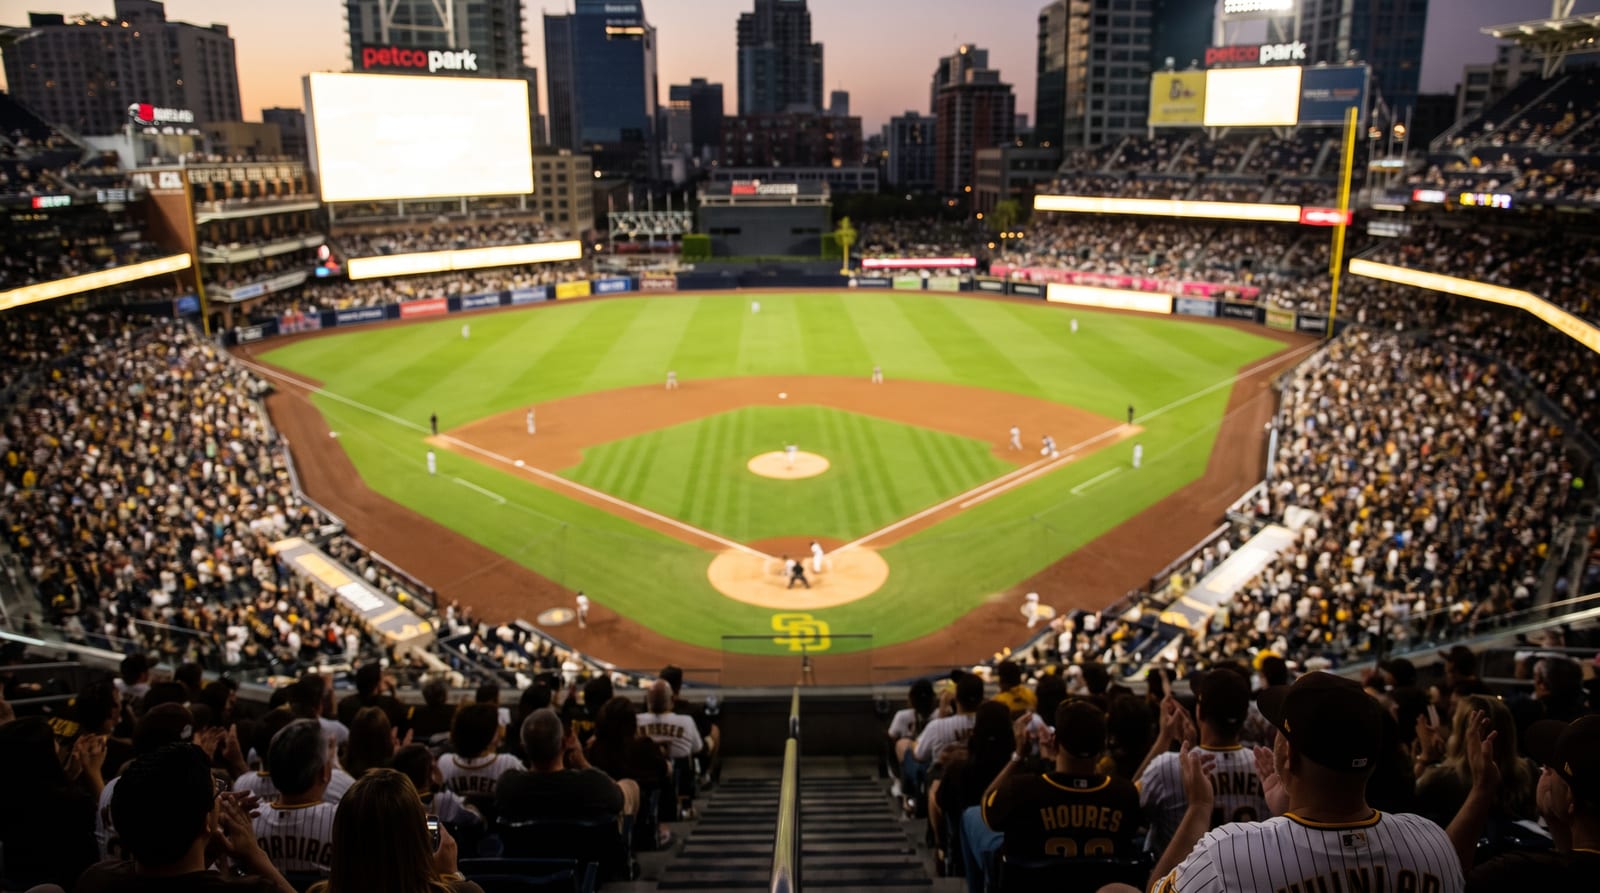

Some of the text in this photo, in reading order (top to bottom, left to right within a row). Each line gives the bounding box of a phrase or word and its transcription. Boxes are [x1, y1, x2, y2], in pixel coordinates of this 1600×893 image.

[362, 45, 478, 73] petco park
[1204, 40, 1307, 66] petco park
[1040, 803, 1124, 833] HOURES
